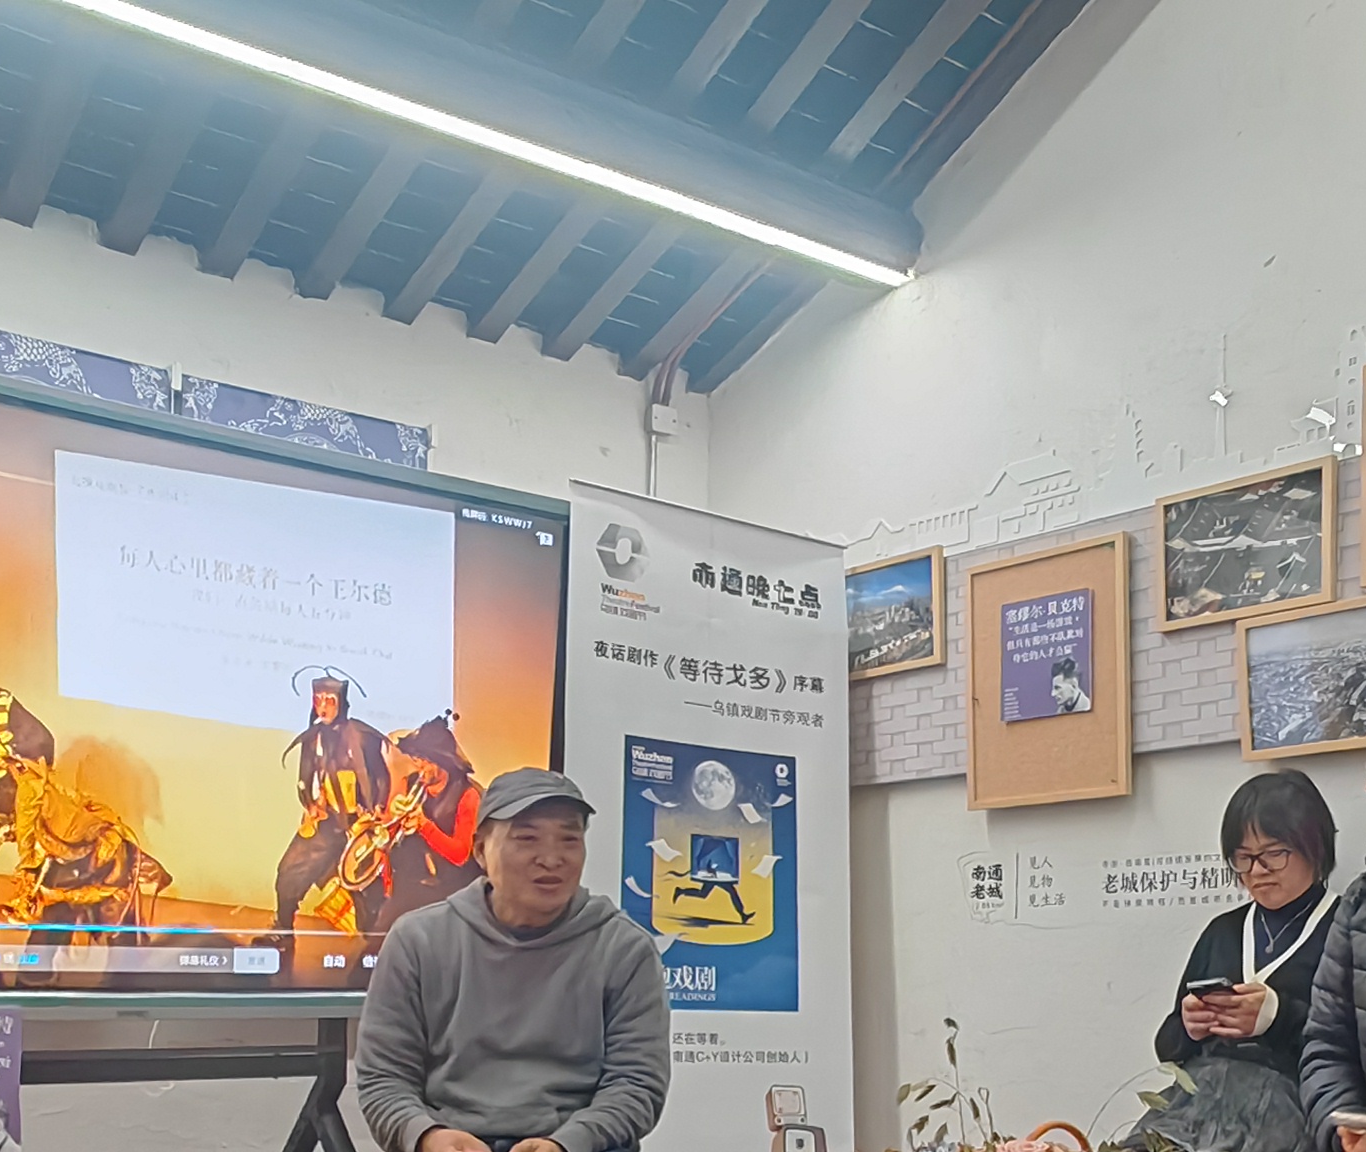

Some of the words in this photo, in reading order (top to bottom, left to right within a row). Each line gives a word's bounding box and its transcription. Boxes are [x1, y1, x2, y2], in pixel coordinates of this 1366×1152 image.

[593, 639, 825, 694] 夜话剧作《等待戈多》序幕
[971, 864, 1003, 881] 南通
[971, 882, 1003, 900] 老城
